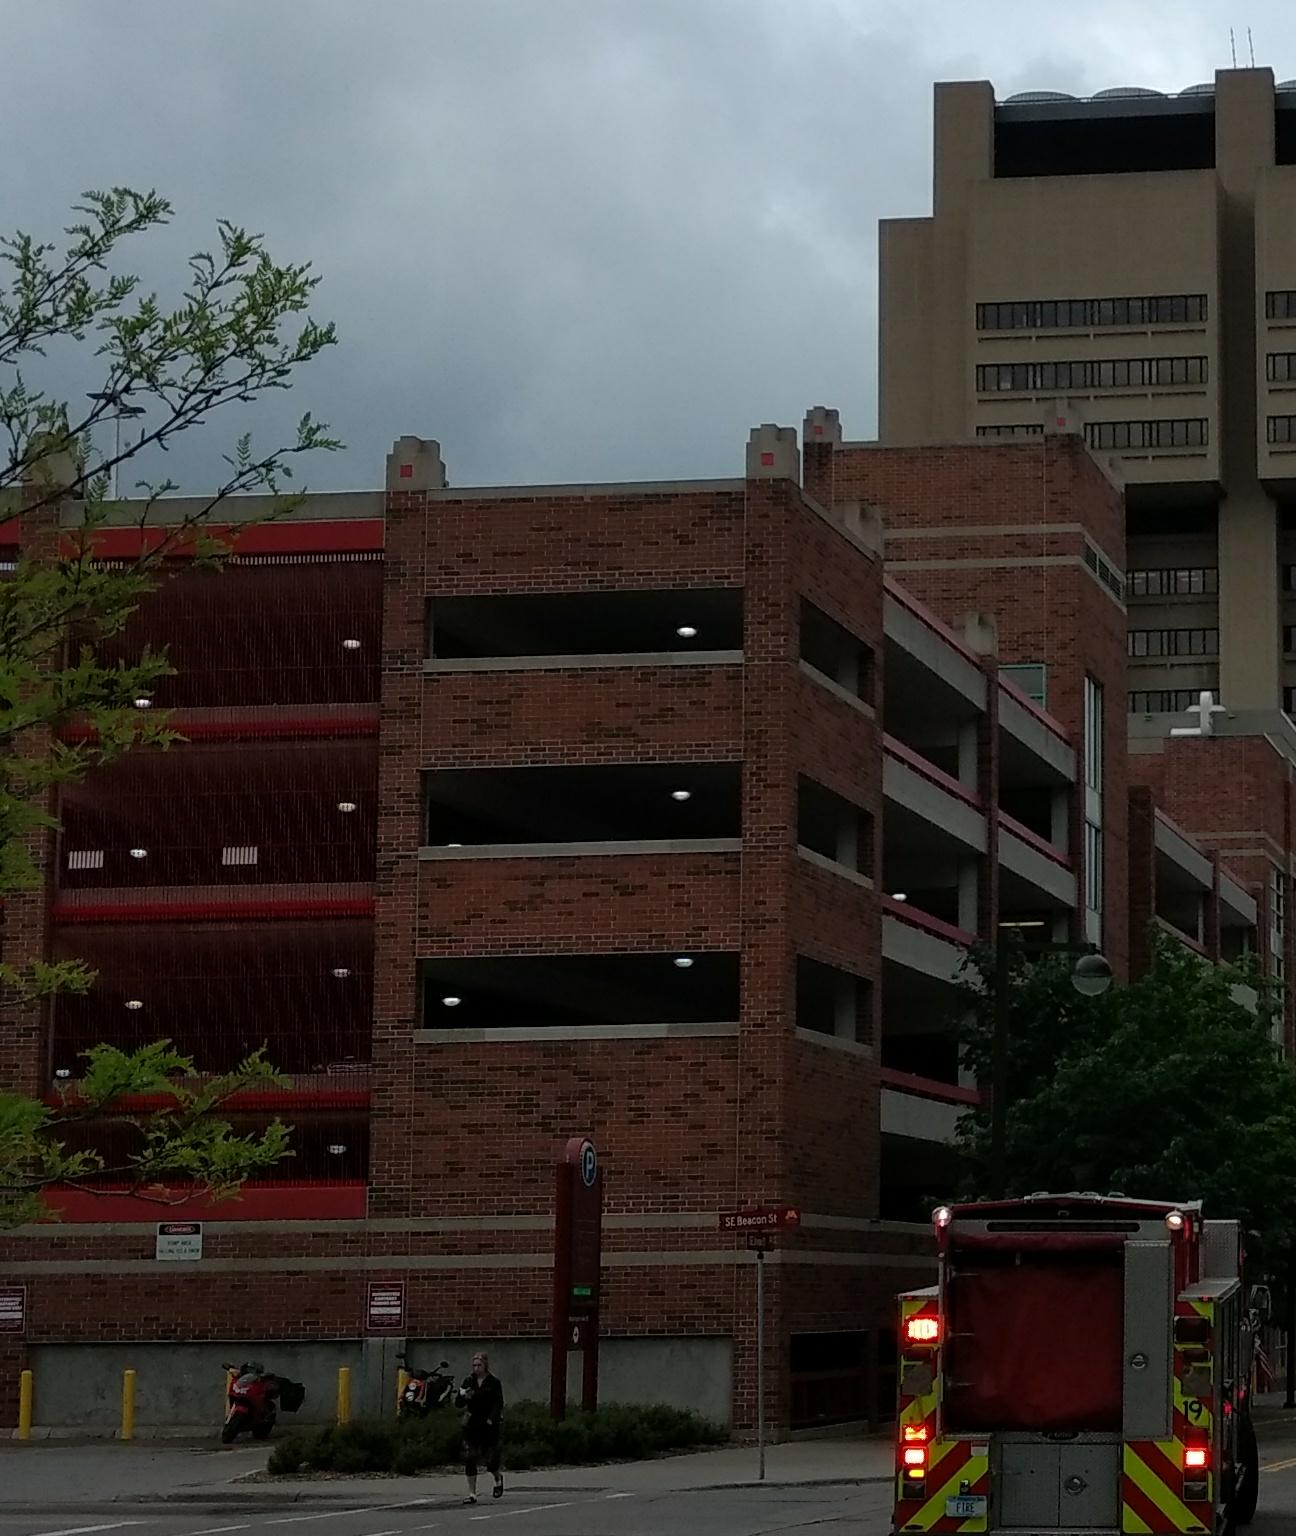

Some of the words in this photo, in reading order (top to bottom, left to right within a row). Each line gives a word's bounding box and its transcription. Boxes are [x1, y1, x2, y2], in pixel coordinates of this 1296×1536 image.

[725, 1216, 736, 1227] SE
[736, 1215, 767, 1226] Beacon
[768, 1213, 778, 1223] St
[1182, 1400, 1203, 1421] 19
[956, 1502, 976, 1513] FIRE
